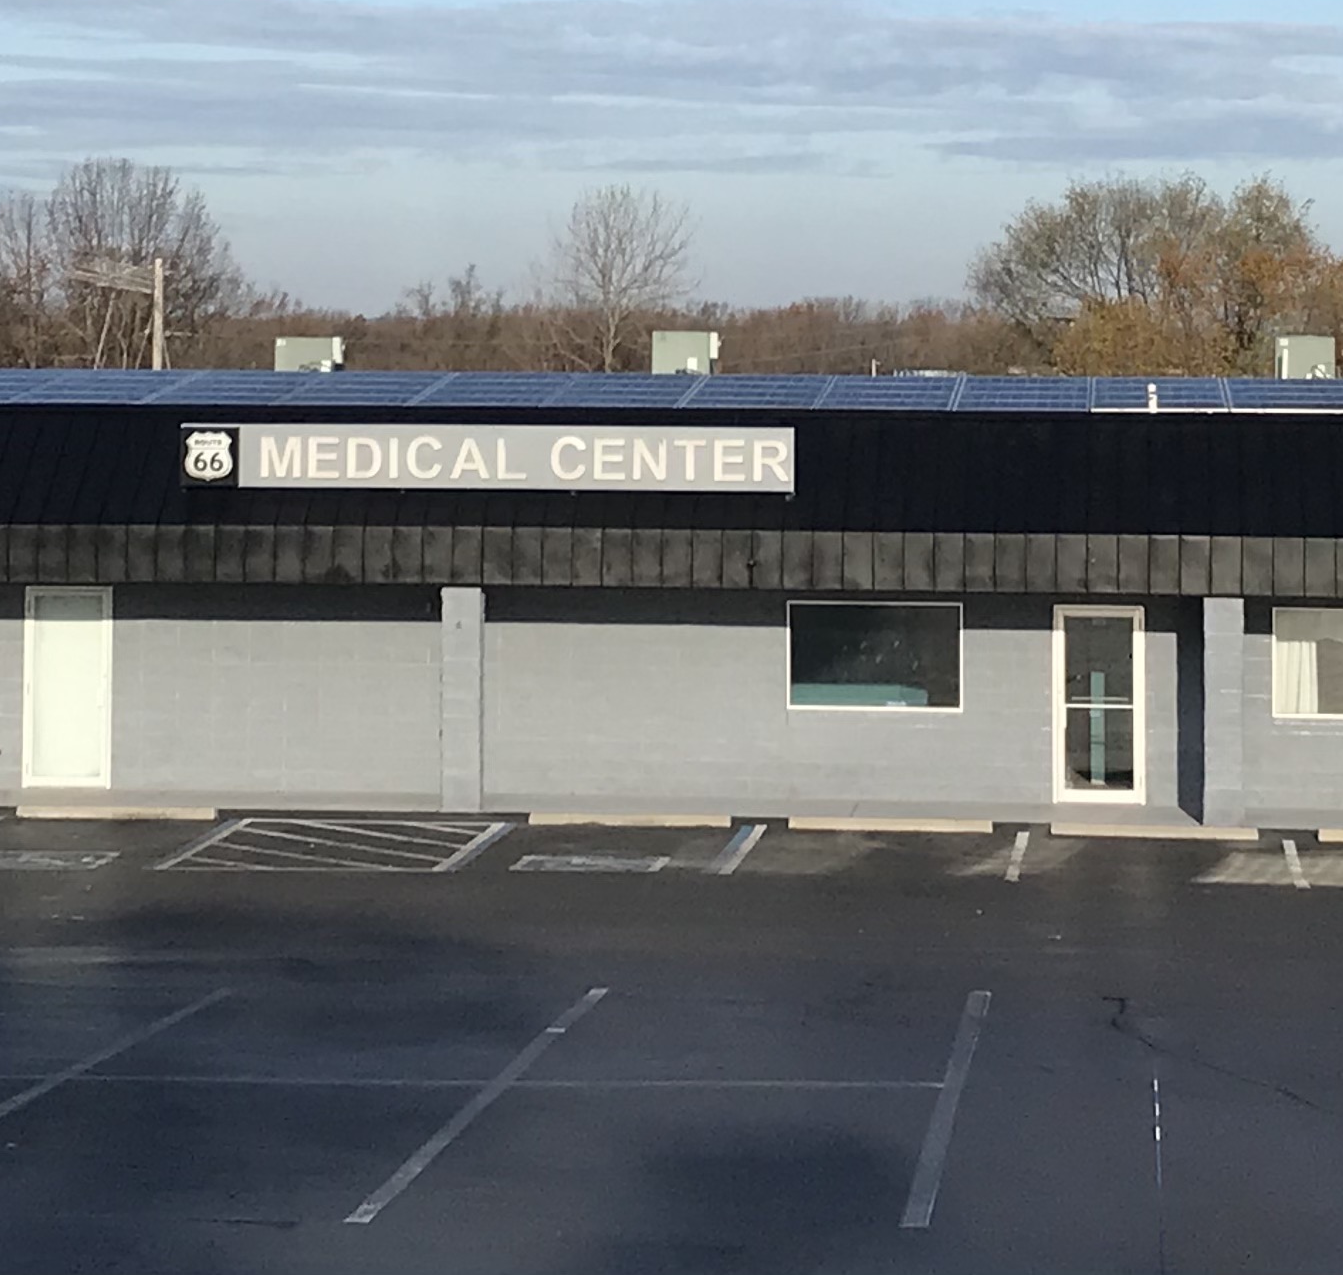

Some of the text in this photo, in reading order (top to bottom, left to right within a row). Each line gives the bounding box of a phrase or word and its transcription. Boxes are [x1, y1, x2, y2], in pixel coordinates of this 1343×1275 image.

[193, 451, 224, 472] 66
[259, 436, 790, 483] MEDICAL CENTER
